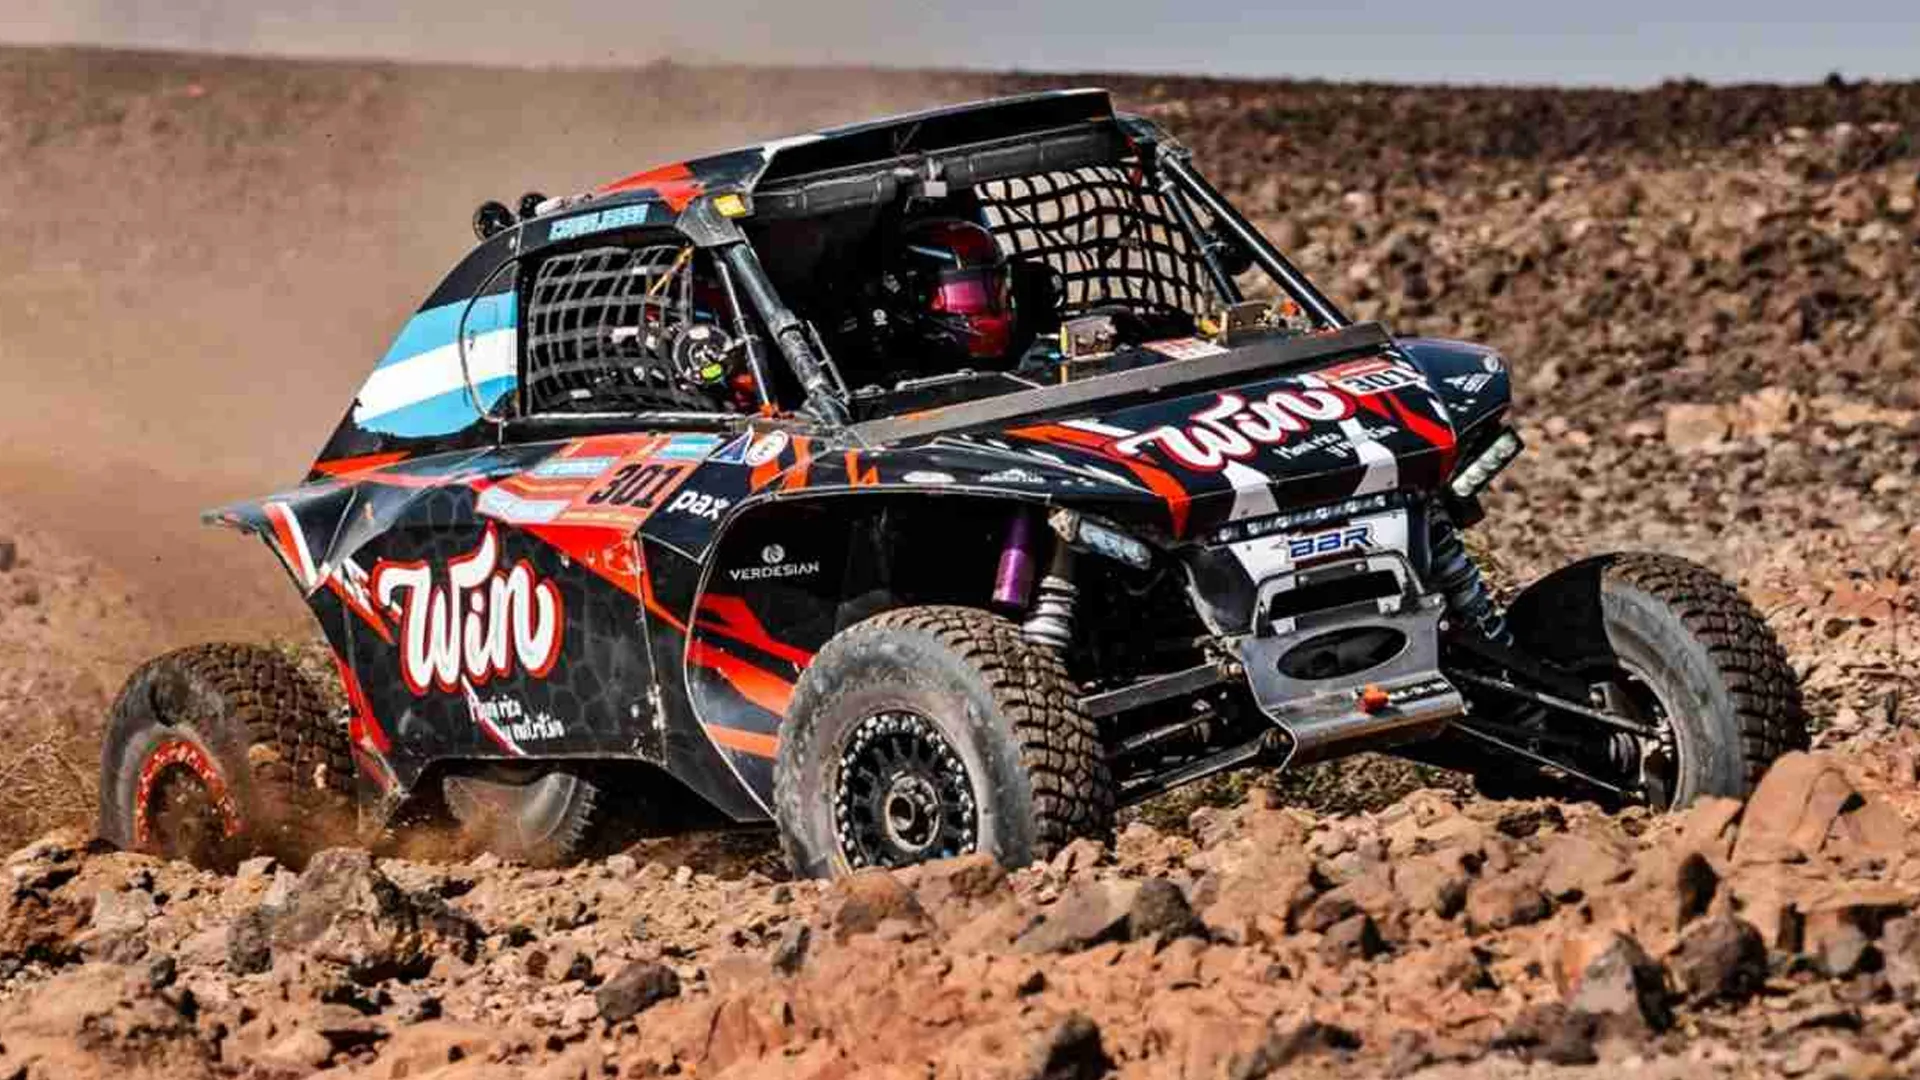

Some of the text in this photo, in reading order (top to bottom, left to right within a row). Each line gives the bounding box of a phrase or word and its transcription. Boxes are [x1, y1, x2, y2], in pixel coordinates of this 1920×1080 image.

[1343, 367, 1415, 392] 301
[1114, 390, 1354, 473] Win
[587, 463, 686, 508] 301
[666, 489, 731, 520] pax
[1288, 526, 1374, 558] BBR
[728, 560, 820, 581] VERDESIAN
[373, 519, 562, 694] Win
